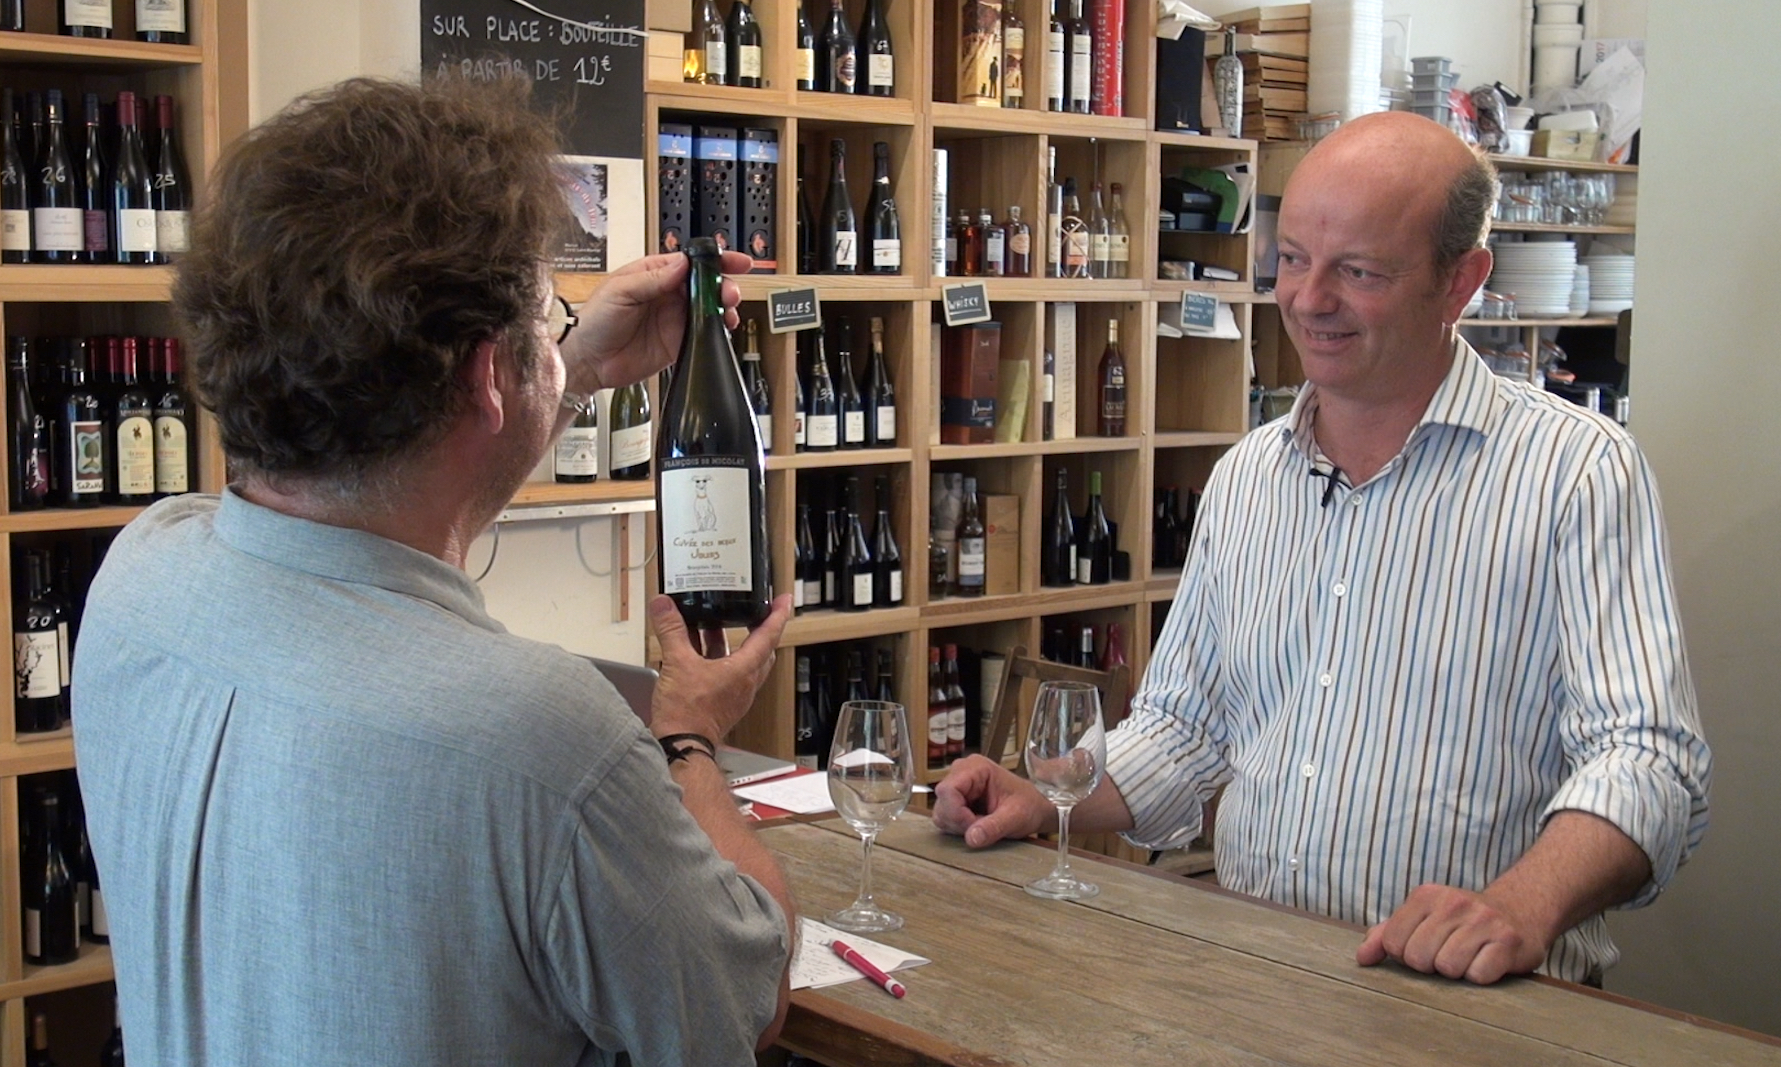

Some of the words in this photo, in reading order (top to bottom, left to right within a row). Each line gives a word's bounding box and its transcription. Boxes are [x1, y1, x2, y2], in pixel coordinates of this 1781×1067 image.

[432, 15, 470, 38] SUR
[486, 16, 541, 42] PLACE
[461, 57, 527, 82] PARTIR
[535, 59, 560, 81] DE
[573, 55, 612, 85] 12€
[41, 166, 66, 184] 26
[775, 301, 812, 317] BULLES
[948, 296, 980, 310] WHISKY
[1058, 319, 1074, 425] Armagnac
[27, 616, 52, 629] 20
